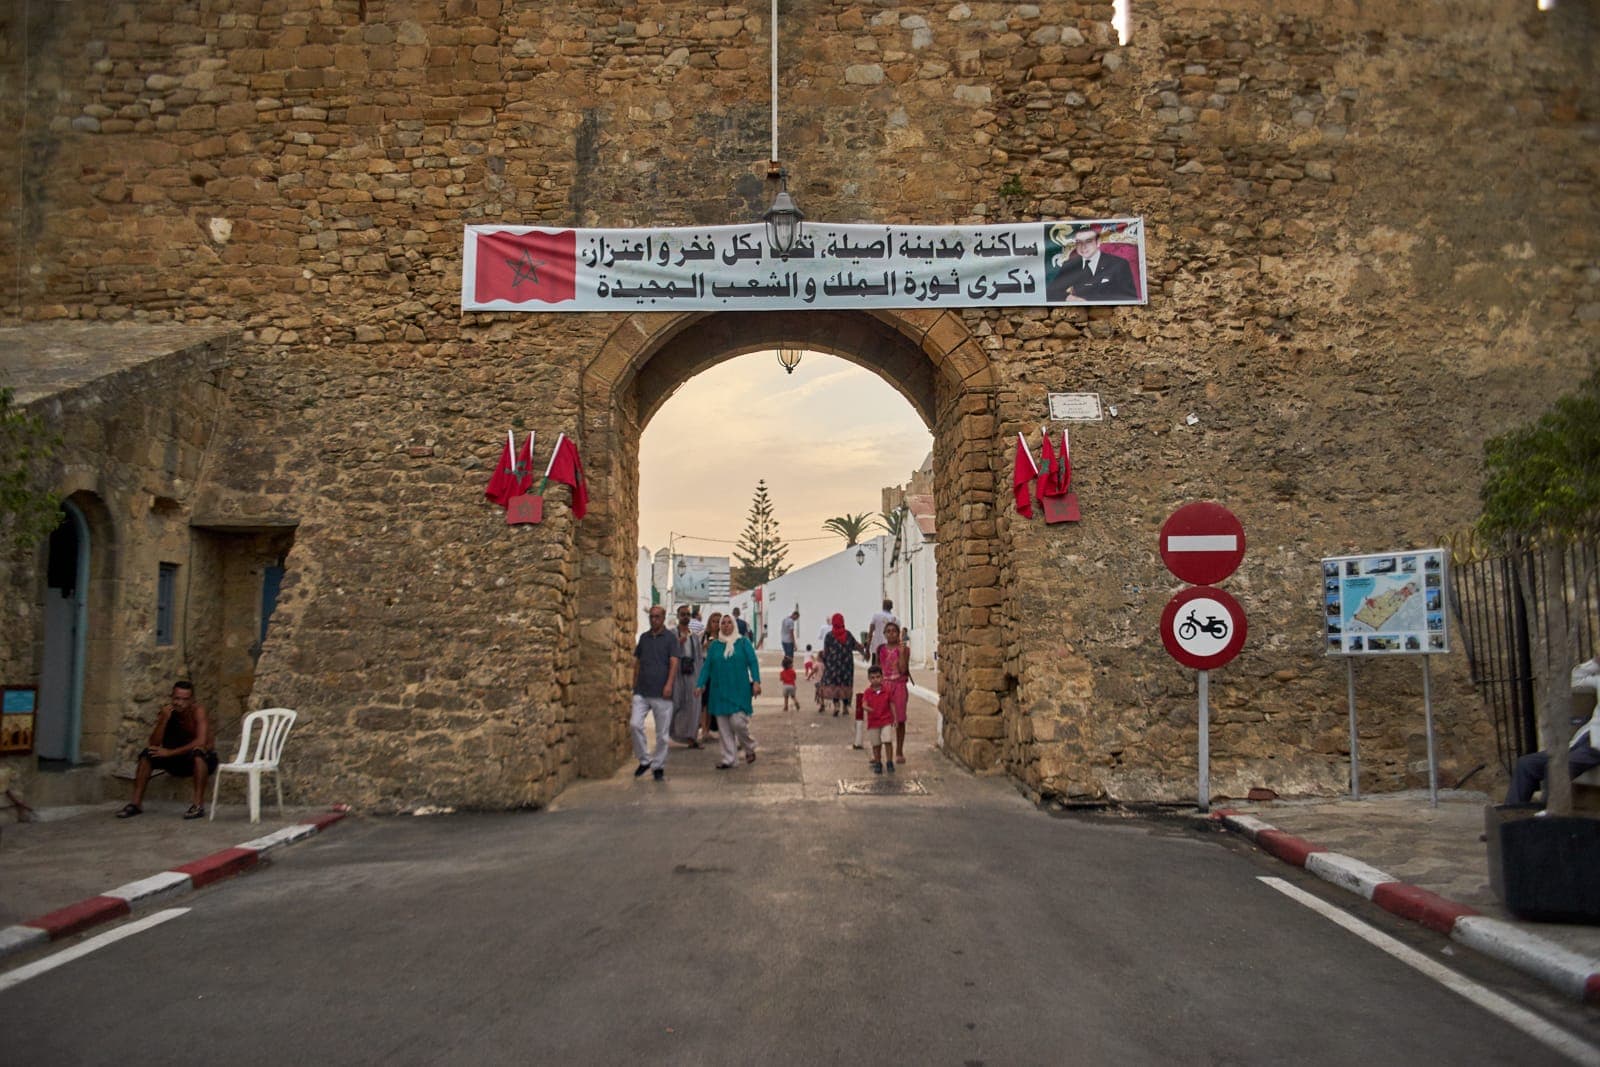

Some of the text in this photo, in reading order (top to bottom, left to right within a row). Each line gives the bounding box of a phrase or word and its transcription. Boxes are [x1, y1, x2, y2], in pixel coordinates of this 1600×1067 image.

[674, 234, 715, 267] فخر
[722, 233, 762, 265] بكل
[899, 233, 965, 264] مدينة
[974, 232, 1038, 257] ساكنة
[597, 273, 704, 304] المجيدة
[712, 272, 798, 303] الشعب
[823, 271, 896, 297] الملك
[904, 269, 960, 301] ثورة
[968, 269, 1035, 300] ذكرى
